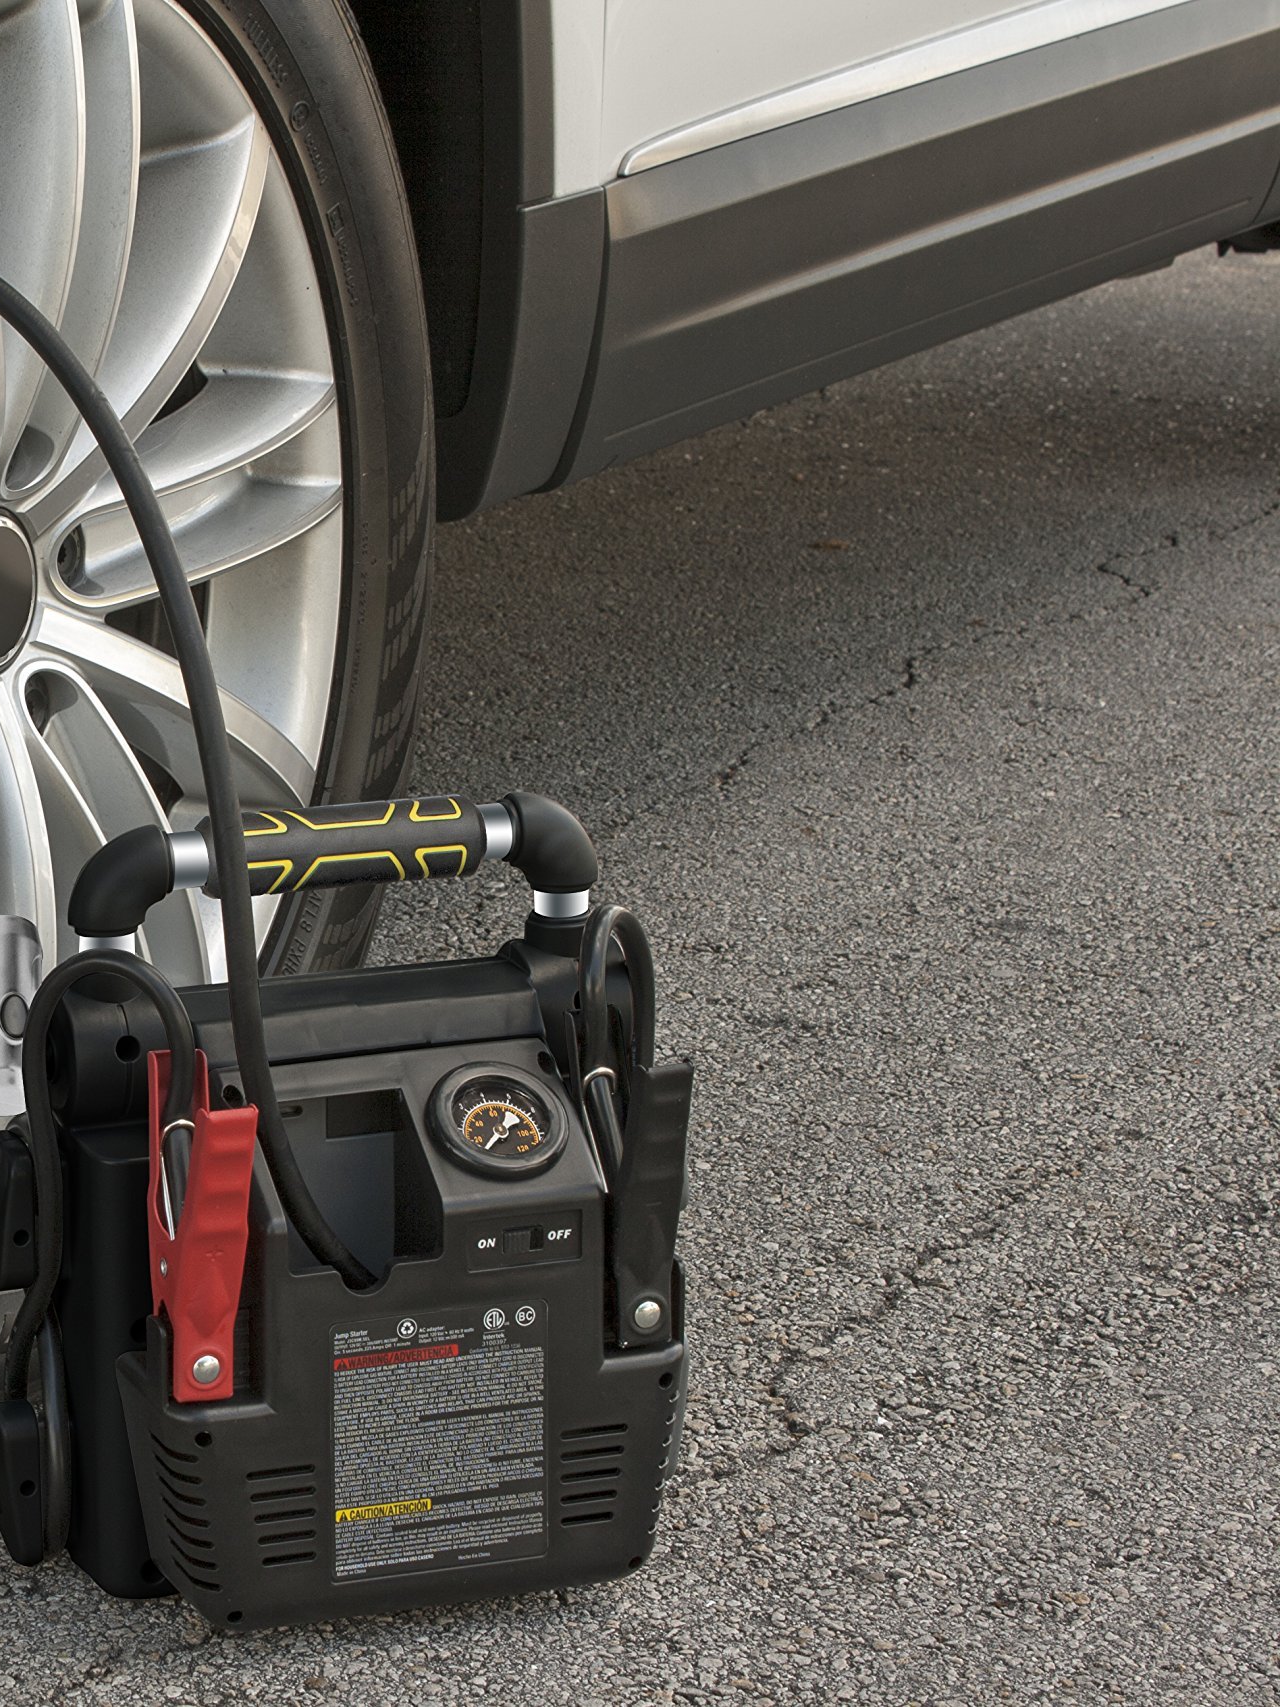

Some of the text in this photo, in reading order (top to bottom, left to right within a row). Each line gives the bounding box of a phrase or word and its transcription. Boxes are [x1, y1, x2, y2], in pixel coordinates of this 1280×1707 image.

[517, 1129, 530, 1137] 100
[477, 1229, 572, 1249] ON OFF
[518, 1310, 533, 1321] BC
[334, 1331, 349, 1340] Jump
[350, 1329, 368, 1338] Starter
[483, 1332, 505, 1340] Intertek
[348, 1346, 453, 1368] WARNING/ADVERTENCIA
[349, 1499, 428, 1520] CAUTION/ATENCIÓN
